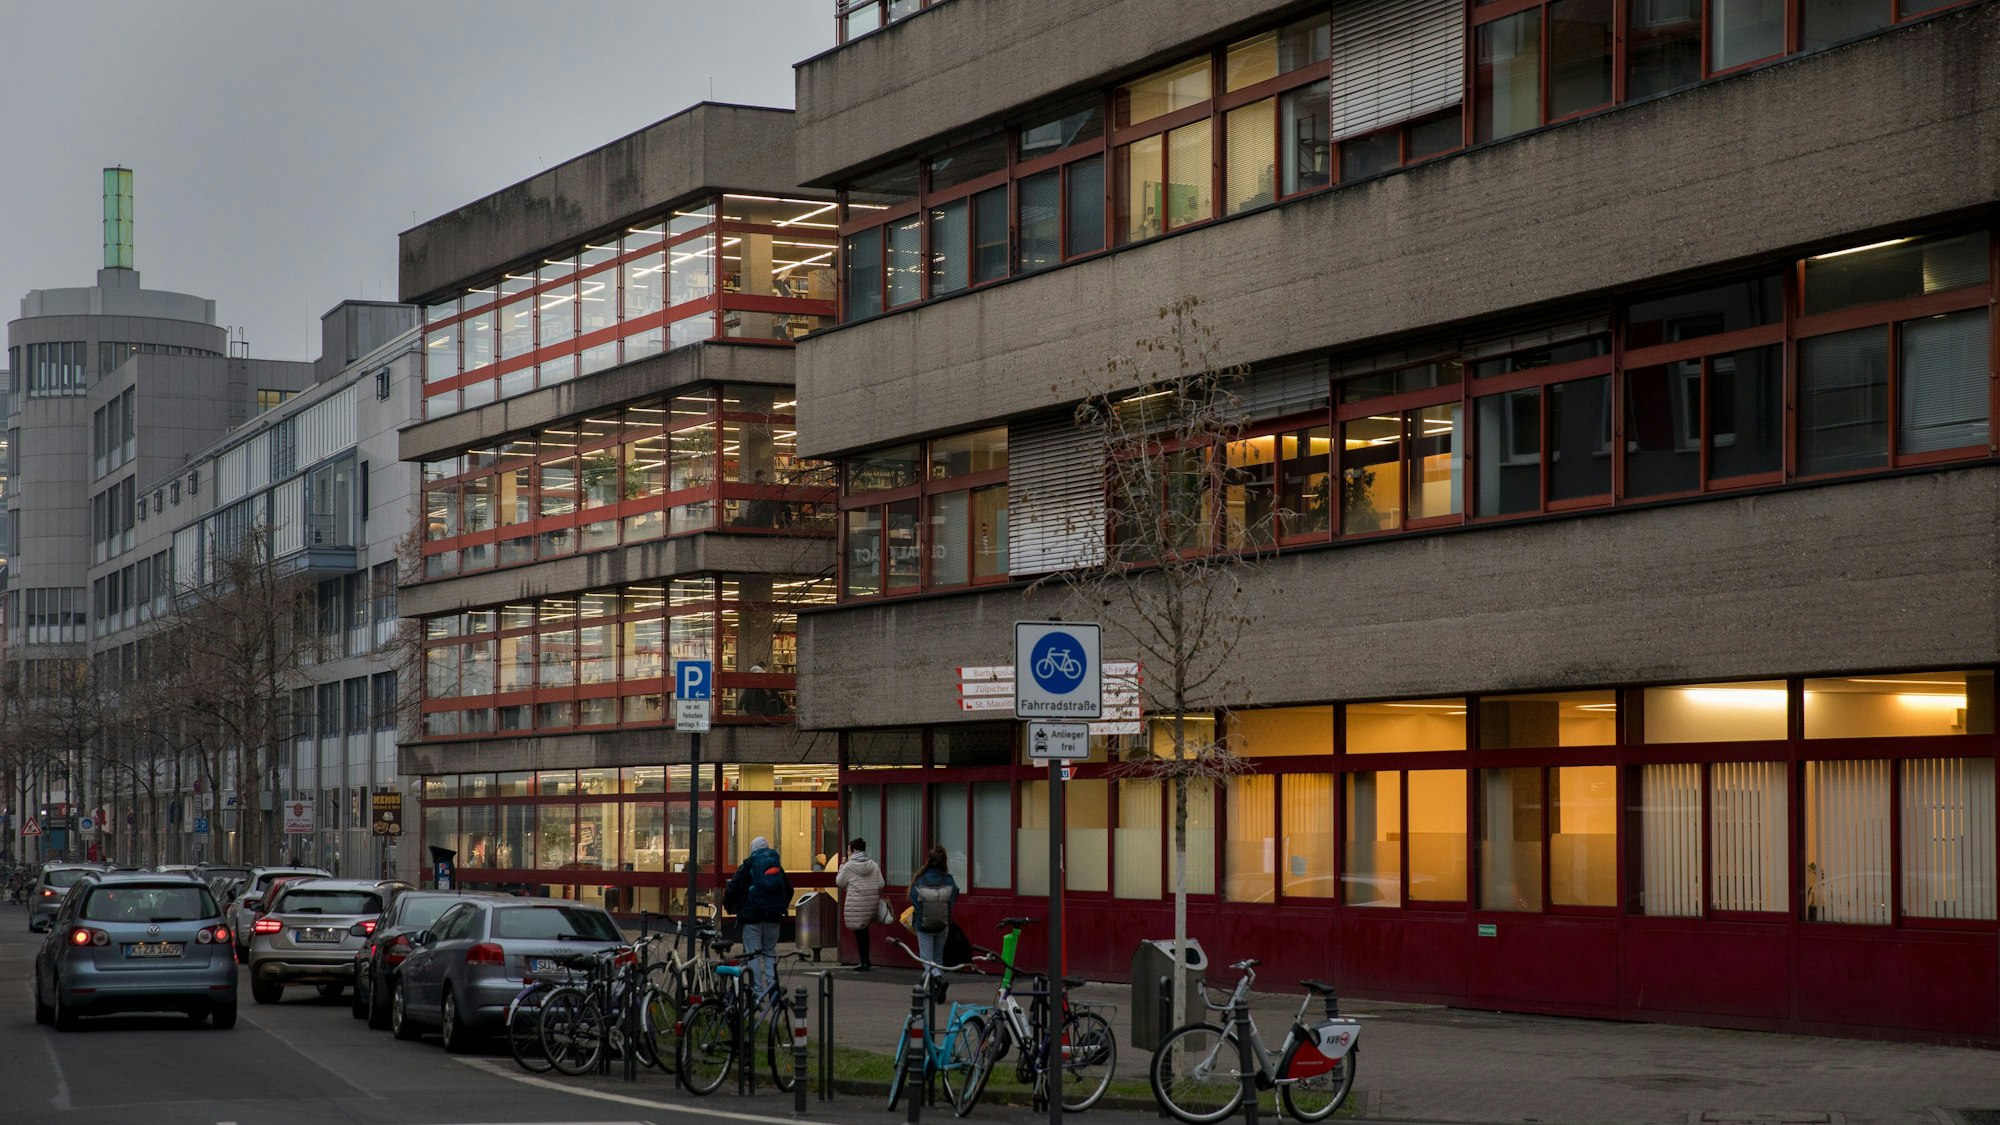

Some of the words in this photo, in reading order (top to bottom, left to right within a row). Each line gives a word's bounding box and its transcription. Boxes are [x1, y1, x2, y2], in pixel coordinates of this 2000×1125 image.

[973, 668, 1014, 678] Barbarossa
[684, 666, 703, 699] P
[974, 684, 1010, 694] Zülpicher
[975, 700, 985, 709] St.
[1021, 699, 1097, 711] Fahrradstraße
[682, 711, 703, 719] Parkschein
[1051, 730, 1085, 740] Anlieger
[1061, 742, 1075, 751] frei
[1326, 1035, 1341, 1044] KVB
